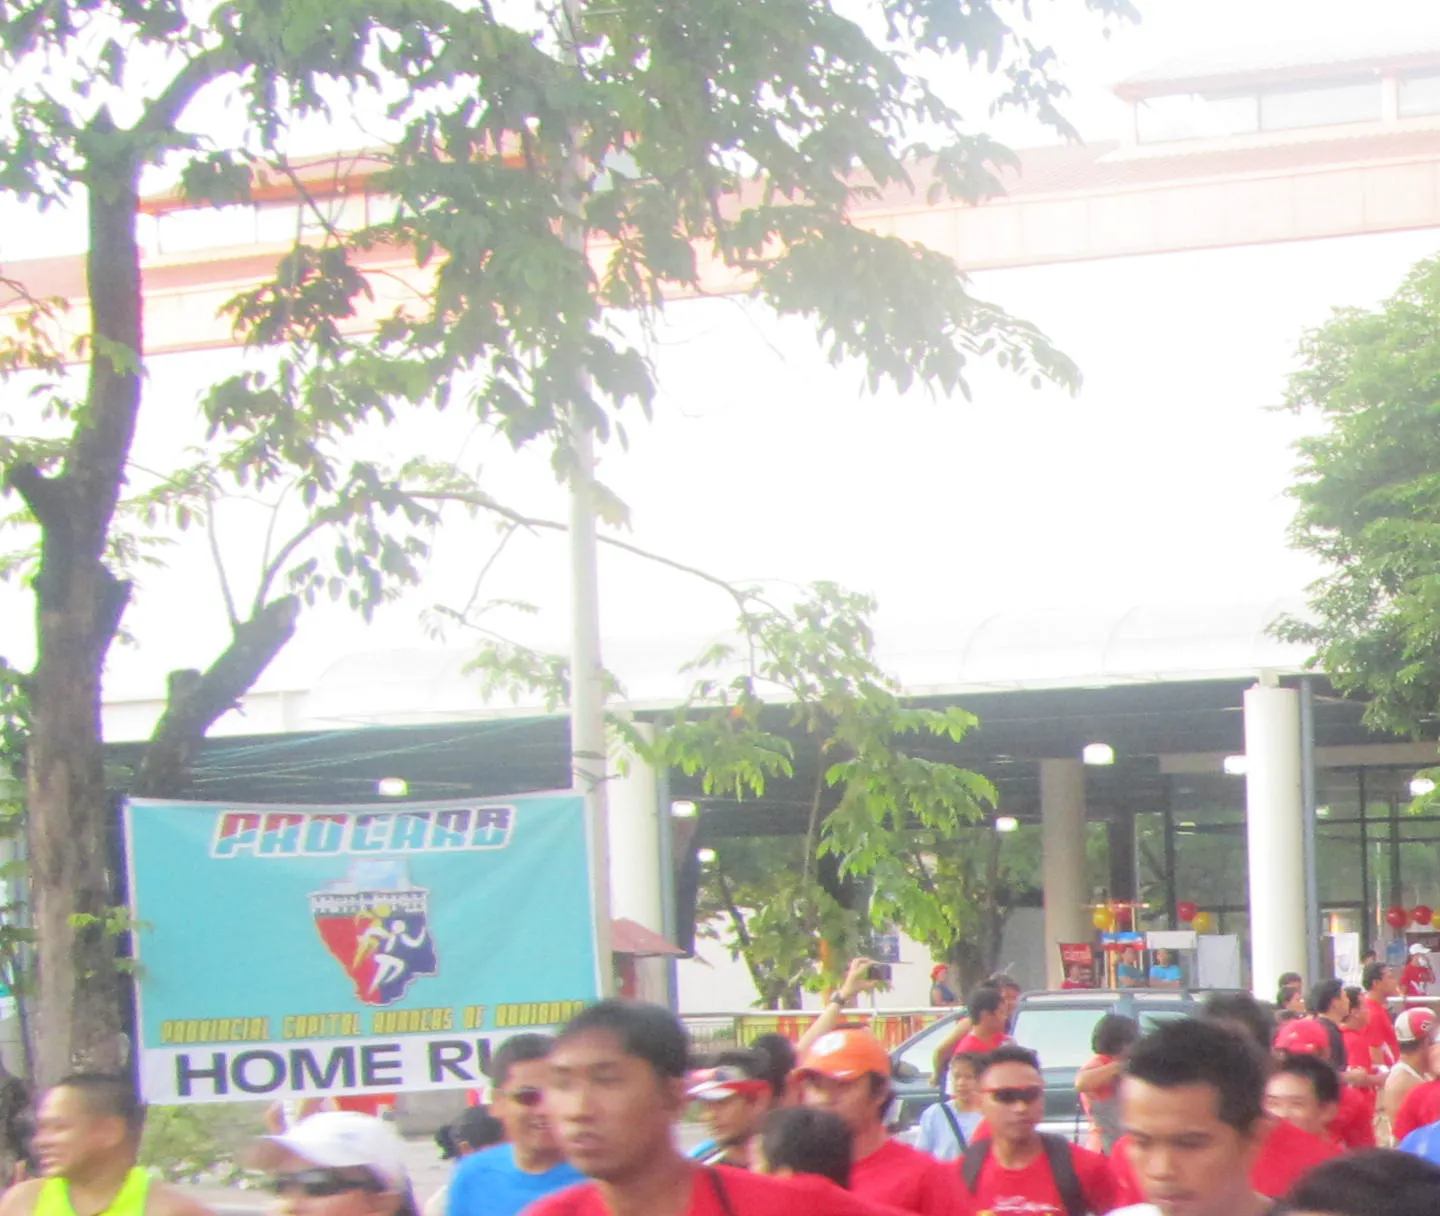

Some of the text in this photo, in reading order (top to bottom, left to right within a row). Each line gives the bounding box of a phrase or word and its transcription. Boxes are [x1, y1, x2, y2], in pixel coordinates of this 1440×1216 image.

[161, 1016, 270, 1044] PROVINCIAL
[282, 1013, 361, 1039] CAPITOL
[372, 1008, 453, 1034] RUNNERS
[463, 1005, 484, 1029] OF
[174, 1043, 403, 1097] HOME
